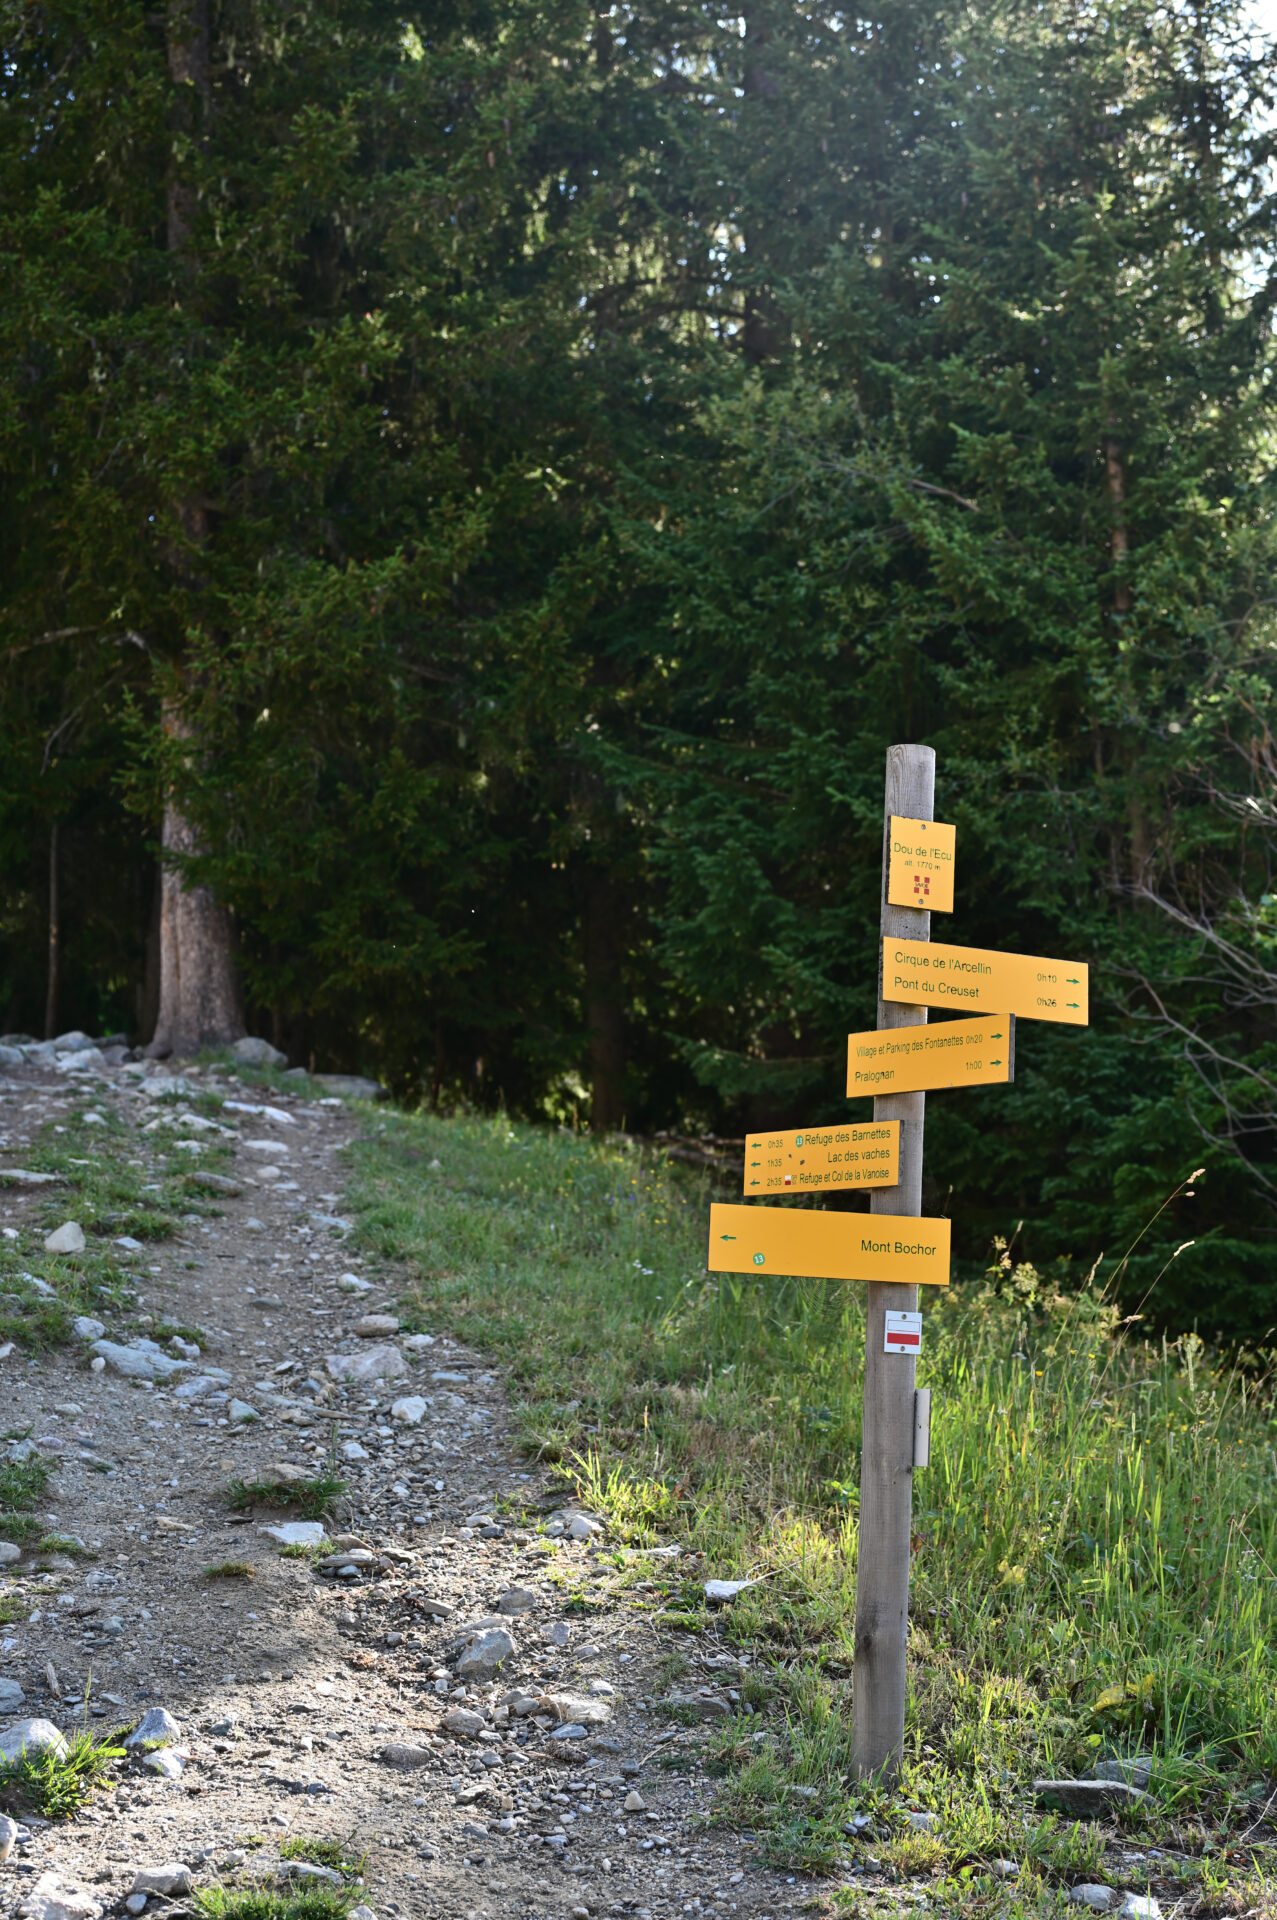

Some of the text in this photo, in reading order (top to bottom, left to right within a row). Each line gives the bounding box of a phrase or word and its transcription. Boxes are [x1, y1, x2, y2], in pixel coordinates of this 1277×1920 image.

[894, 842, 952, 860] Dou de l'Ecu
[917, 861, 933, 870] 1770
[894, 951, 992, 975] Cirque de l'Arcellin
[894, 976, 979, 998] Pont du Creuset
[1036, 973, 1057, 984] 0h10
[856, 1034, 983, 1058] Village et Parking des Fontanettes 0h20
[965, 1060, 982, 1071] 1h00
[854, 1069, 895, 1083] Pralognan
[767, 1139, 784, 1149] 0h35
[804, 1133, 833, 1146] Refuge
[835, 1131, 850, 1142] des
[852, 1128, 891, 1141] Barnettes
[767, 1148, 890, 1167] 1h35 Lac des vaches
[766, 1177, 782, 1187] 2h35
[799, 1172, 823, 1185] Refuge
[823, 1172, 831, 1181] et
[831, 1169, 843, 1182] Col
[844, 1169, 853, 1181] de
[854, 1170, 861, 1180] la
[861, 1167, 890, 1180] Vanoise
[860, 1239, 937, 1256] Mont Bochor
[754, 1254, 764, 1264] 13
